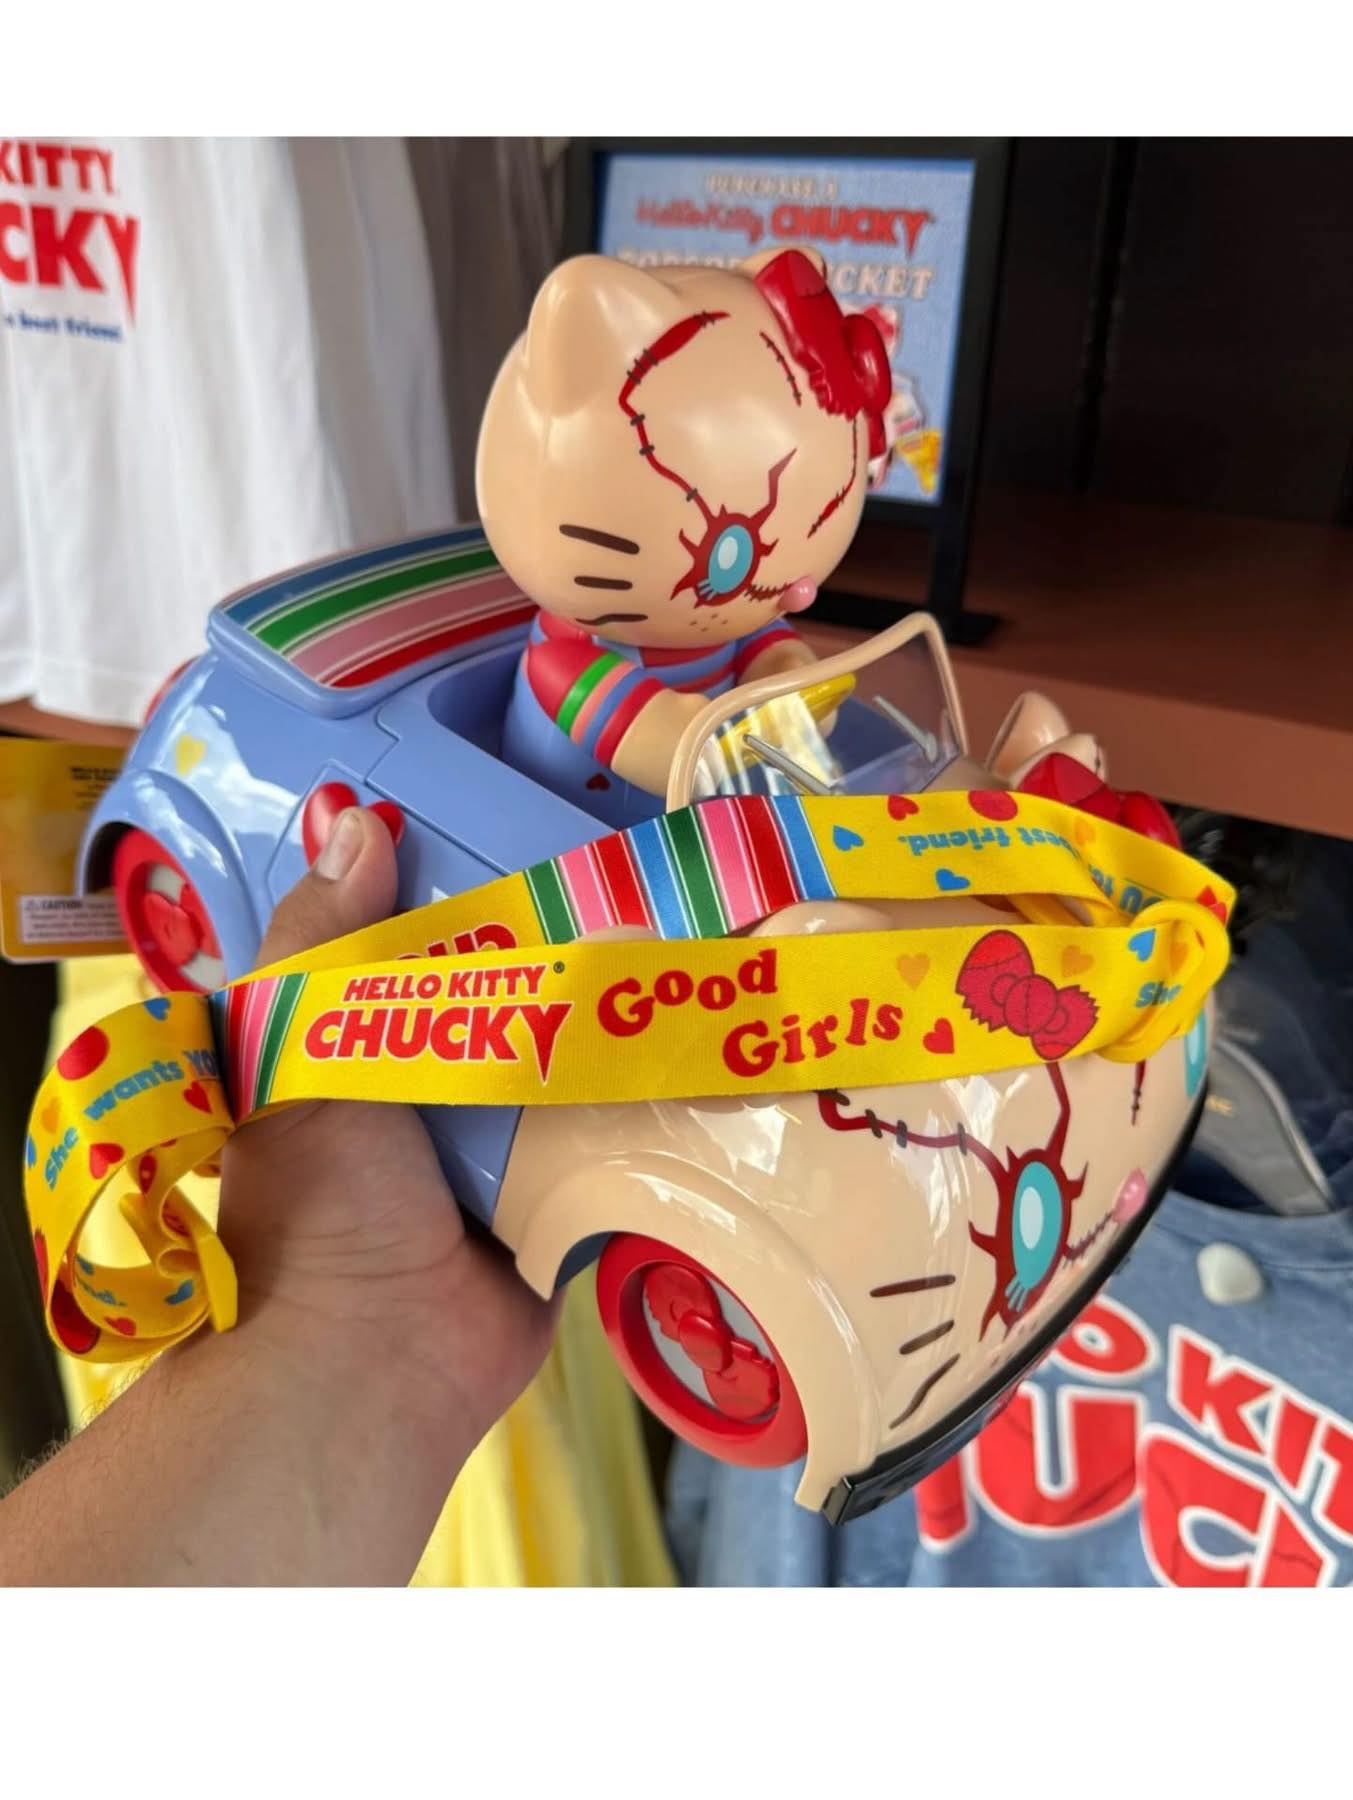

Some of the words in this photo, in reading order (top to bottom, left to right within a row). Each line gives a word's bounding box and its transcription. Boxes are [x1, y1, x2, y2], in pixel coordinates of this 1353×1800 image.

[770, 203, 929, 257] CHUCKY
[343, 974, 443, 1001] HELLO
[447, 963, 547, 999] KITTY
[597, 949, 778, 1037] Good
[304, 1002, 574, 1083] CHUCKY
[722, 999, 904, 1078] Girls
[44, 1126, 79, 1191] She
[83, 1060, 184, 1120] wants
